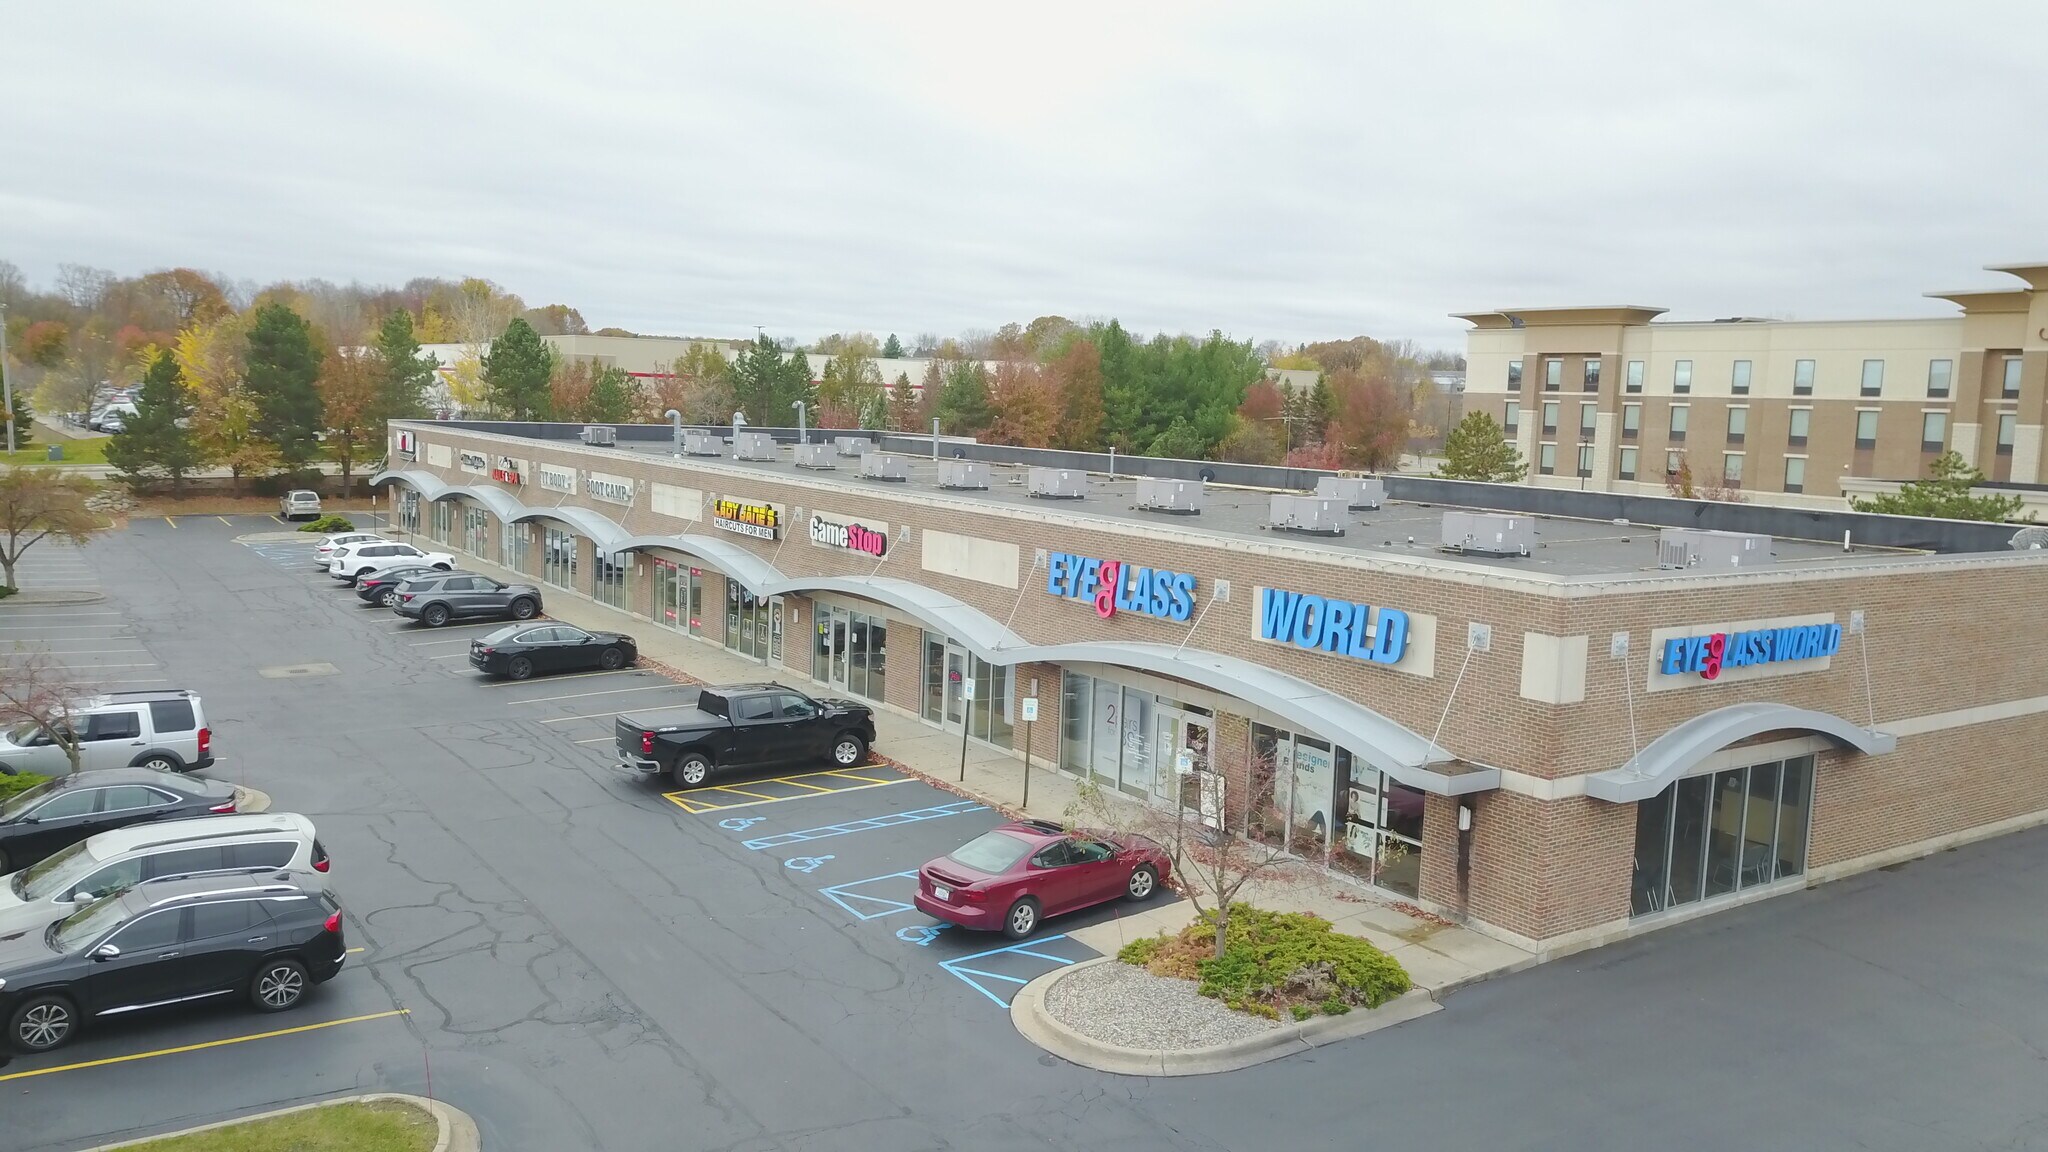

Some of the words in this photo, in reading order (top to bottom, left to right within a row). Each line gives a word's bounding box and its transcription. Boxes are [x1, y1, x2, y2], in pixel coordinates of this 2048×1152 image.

[550, 472, 566, 488] BODY
[587, 479, 604, 495] BOOT
[605, 482, 627, 500] CAMP
[714, 499, 740, 520] LADY
[715, 518, 744, 533] HAIRCUTS
[745, 525, 757, 536] FOR
[758, 527, 772, 539] MEN
[809, 516, 886, 556] GameStop
[1262, 588, 1410, 664] WORLD
[1773, 623, 1842, 662] WORLD
